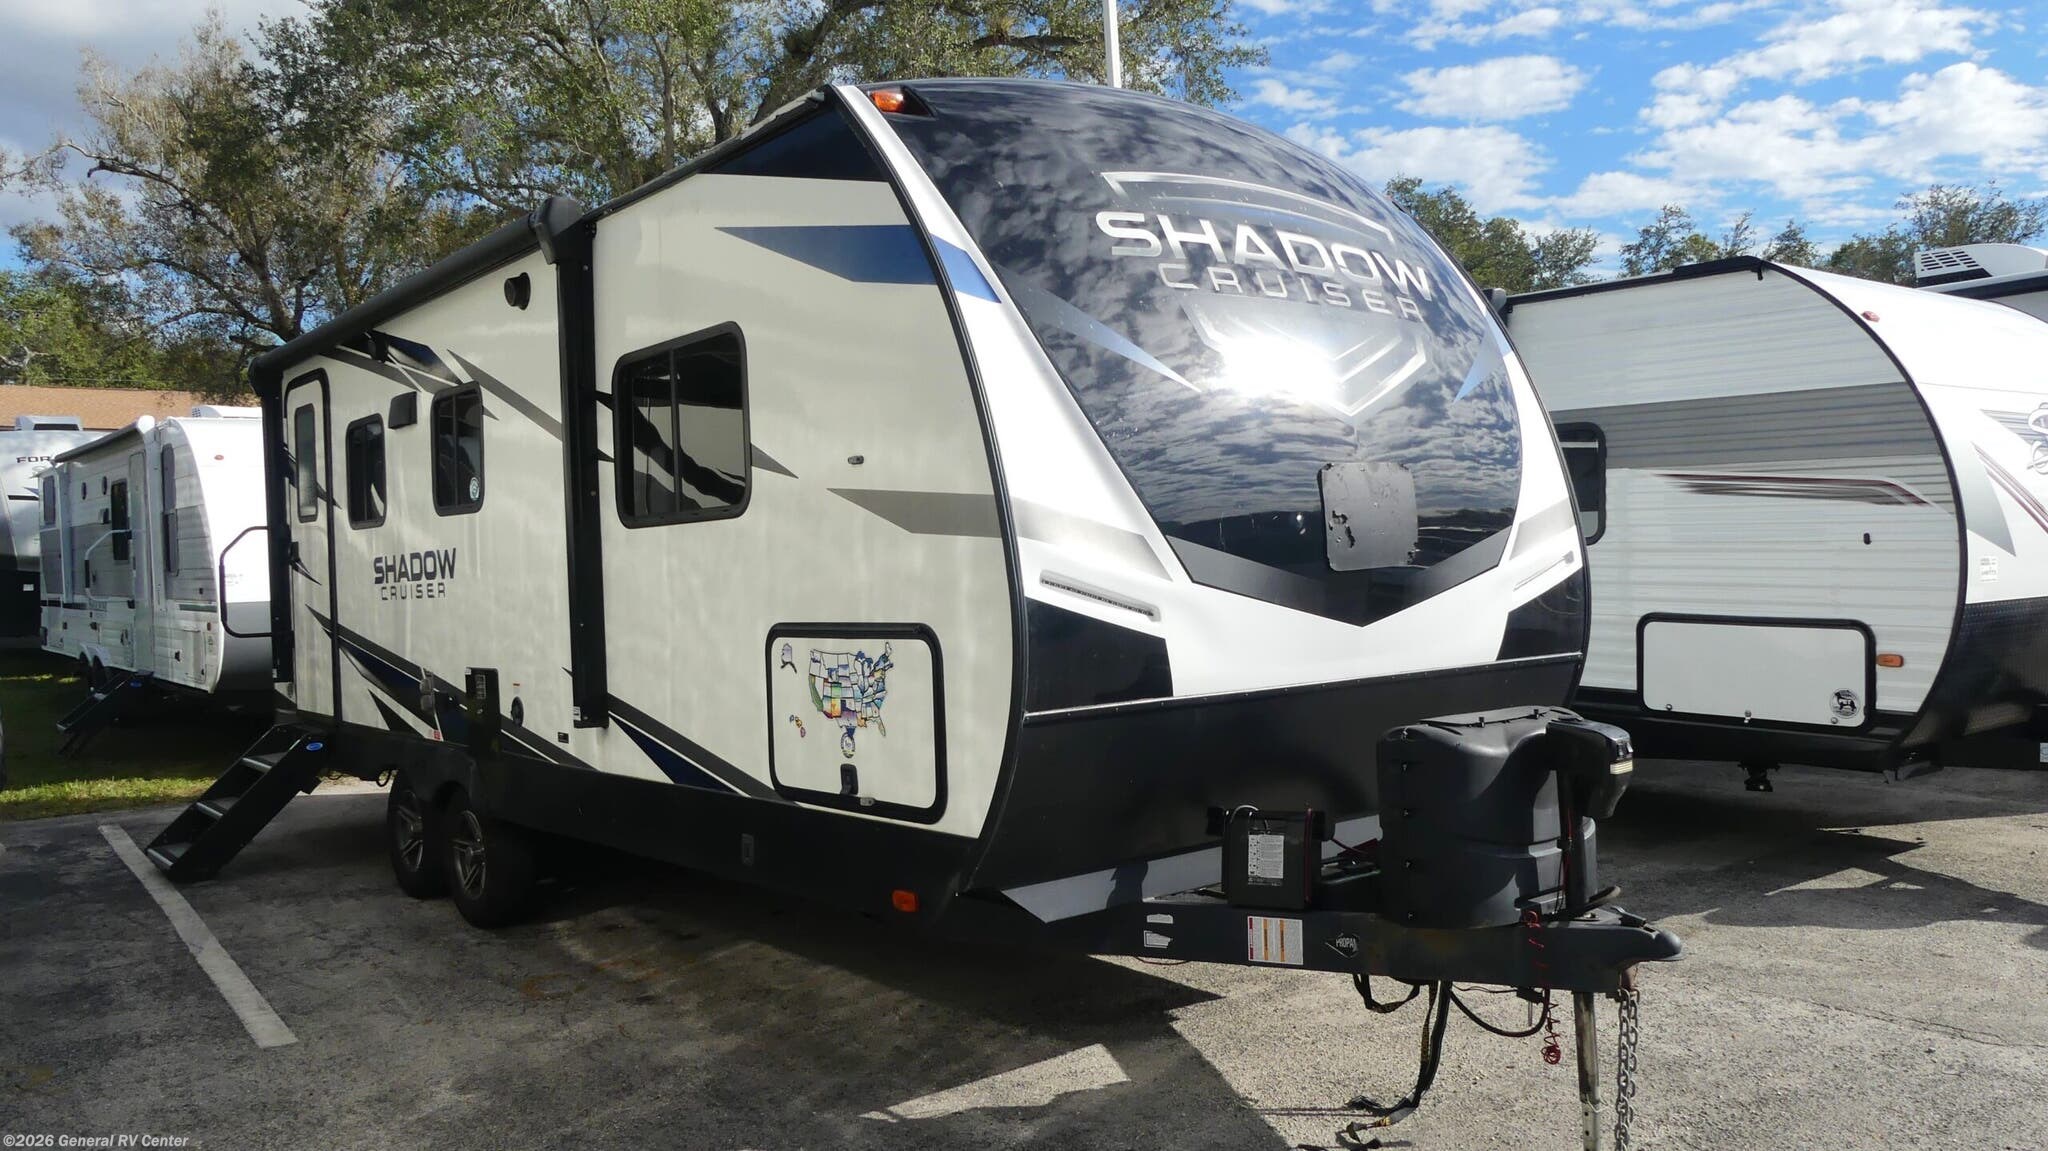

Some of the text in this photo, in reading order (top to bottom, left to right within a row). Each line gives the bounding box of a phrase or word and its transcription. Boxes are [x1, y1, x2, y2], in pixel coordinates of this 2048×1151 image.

[1096, 211, 1432, 301] SHADOW
[1158, 263, 1424, 322] CRUISER
[373, 547, 456, 584] SHADOW
[381, 582, 446, 601] CRUISER
